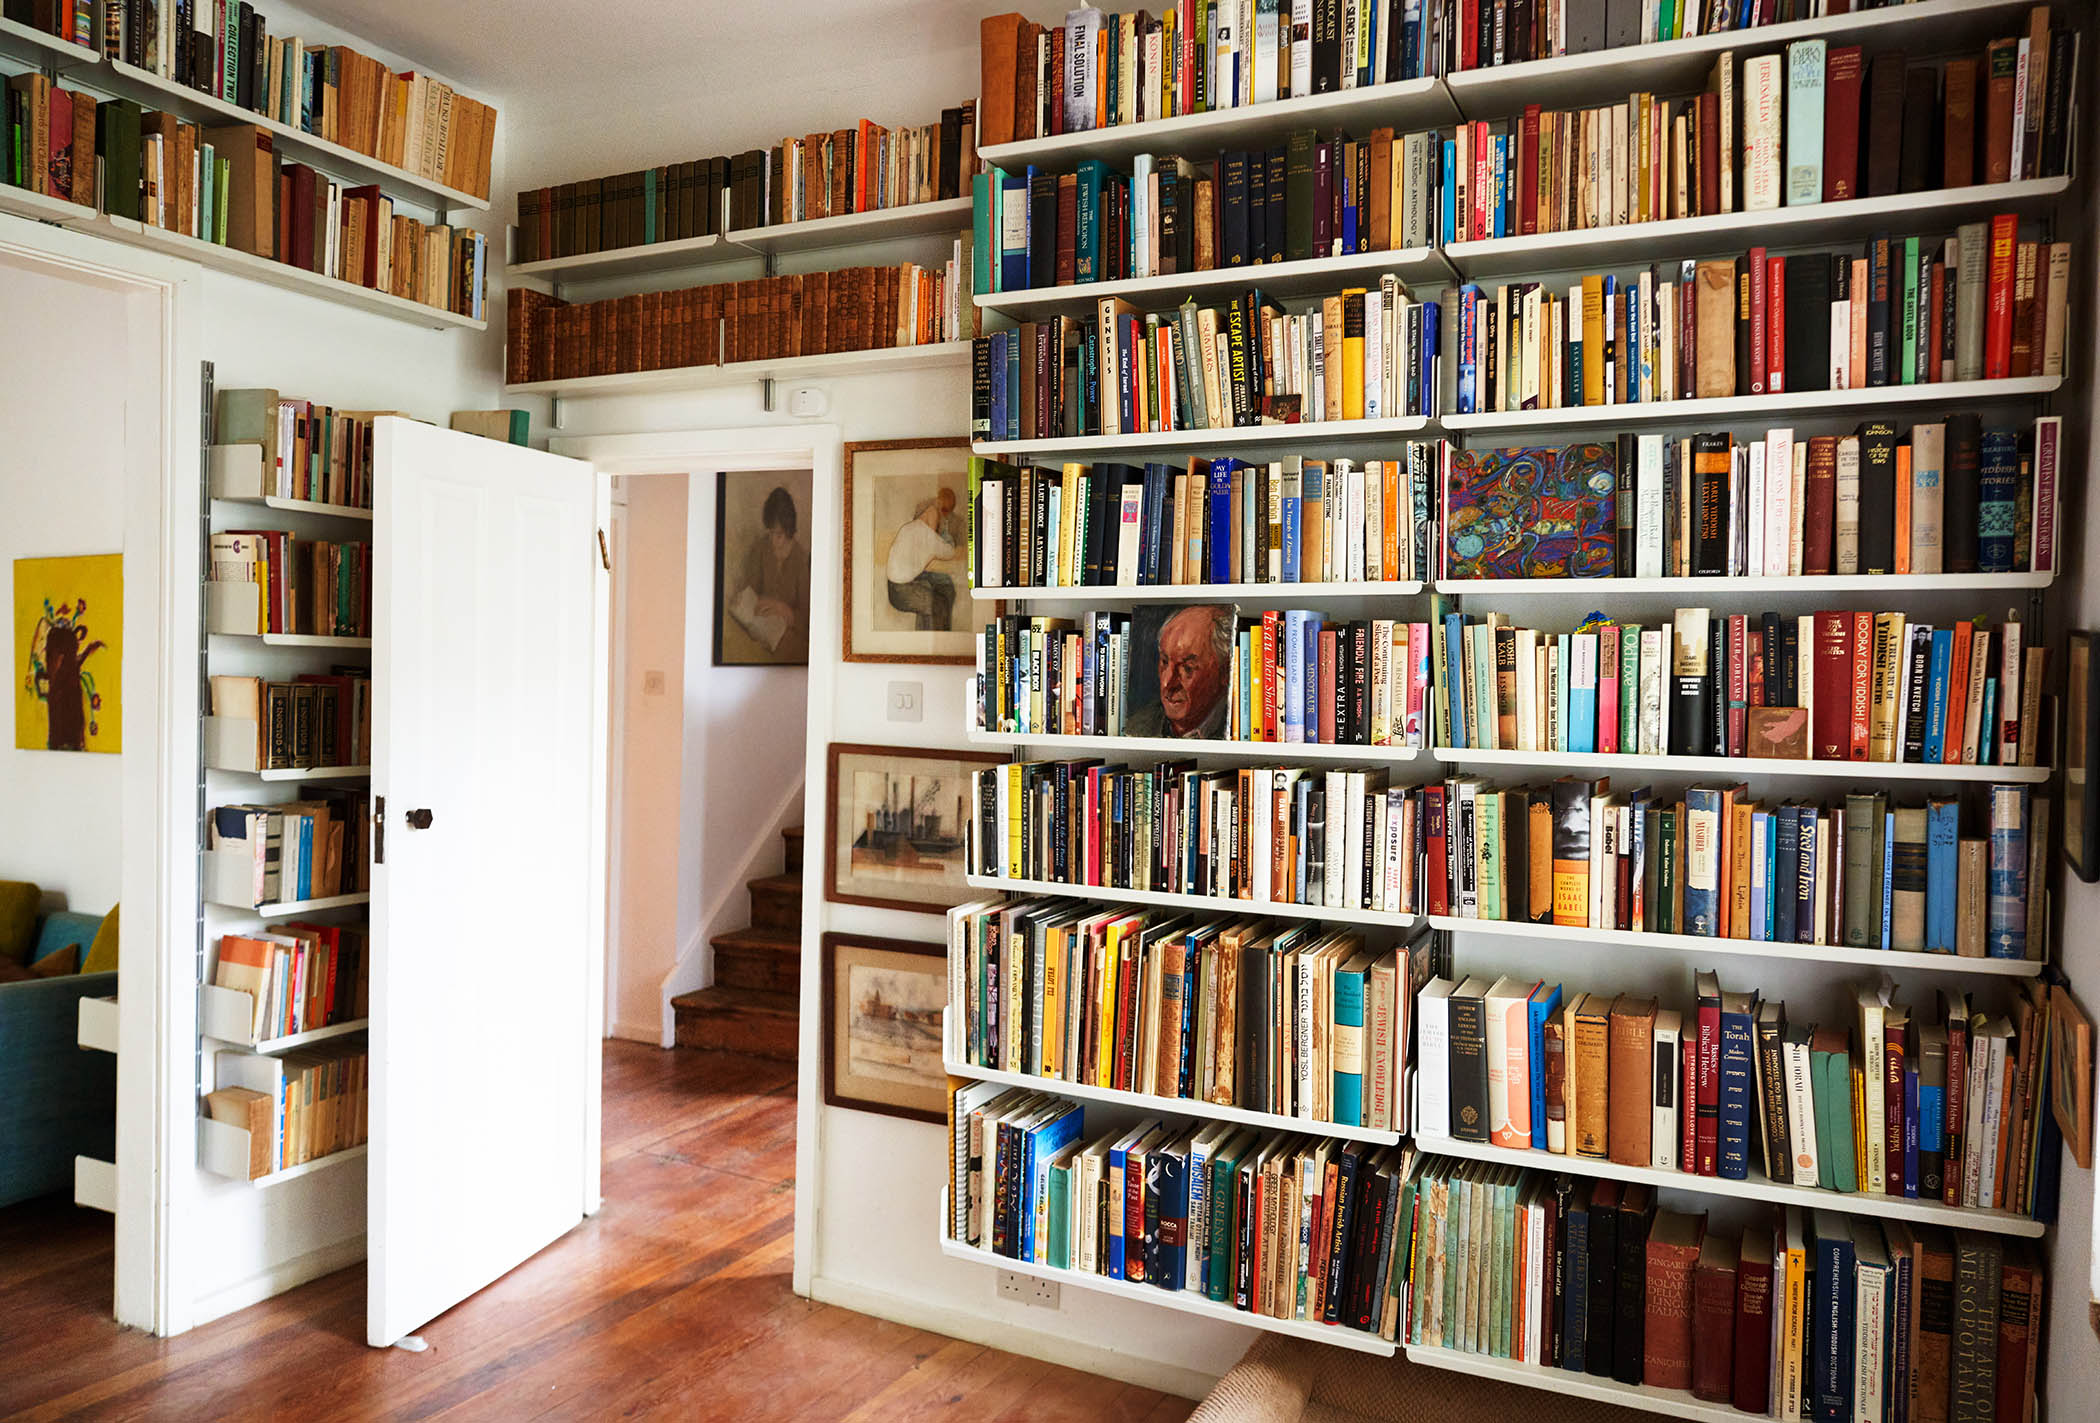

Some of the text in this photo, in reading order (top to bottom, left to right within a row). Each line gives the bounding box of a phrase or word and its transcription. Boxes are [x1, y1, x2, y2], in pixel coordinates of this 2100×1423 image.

[1346, 6, 1356, 36] SILENCE
[225, 23, 238, 100] COLLECTION TWO
[1073, 25, 1086, 98] FINAL SOLUTION
[1149, 36, 1158, 74] KONIN
[1759, 61, 1771, 123] JERUSALEM
[1081, 182, 1089, 211] JEWISH
[1410, 189, 1418, 236] ANTHOLOGY
[1457, 184, 1465, 229] ON JUDAISM
[1994, 239, 2012, 258] KID
[1383, 279, 1393, 311] ALL ABOUT
[1105, 306, 1114, 375] GENESIS
[1203, 323, 1213, 373] SURVIVORS
[1230, 312, 1242, 346] ESCAPE
[1466, 292, 1475, 365] Why Blame Israel?
[1037, 334, 1046, 374] Jerusalem
[1087, 334, 1098, 376] Catastrophe
[1232, 350, 1245, 383] ARTIST
[1089, 380, 1098, 404] Power
[1122, 376, 1130, 394] Israel
[1037, 489, 1045, 503] LATE
[1037, 504, 1045, 528] DIVORCE
[1268, 479, 1280, 520] Ben Gurion
[1709, 481, 1719, 540] EARLY YIDDISH
[1291, 616, 1298, 627] MY
[1374, 624, 1382, 648] Silence
[1735, 619, 1744, 652] MASTER
[1890, 633, 1897, 641] A
[1031, 651, 1041, 691] BLACK BOX
[1263, 614, 1275, 718] Esau Meir Shalev
[1354, 628, 1365, 684] FRIENDLY FIRE
[1374, 650, 1382, 659] of
[1379, 625, 1390, 685] The Continuing
[1497, 642, 1506, 665] KALB
[1506, 638, 1515, 665] YOSHE
[1623, 634, 1638, 686] Old Love
[1855, 615, 1869, 721] HOORAY FOR YIDDISH!
[1874, 620, 1891, 706] YIDDISH POETRY
[1887, 642, 1897, 684] TREASURY
[1306, 663, 1316, 714] MINOTAUR
[1373, 667, 1381, 685] Poet
[1735, 661, 1743, 699] DREAMS
[1911, 654, 1925, 713] BORN TO KVETCH
[1336, 686, 1346, 739] THE EXTRA
[1931, 677, 1942, 737] YIDDISH LITERATURE
[1153, 790, 1161, 814] AHARON
[1447, 800, 1456, 833] Nineteen
[1278, 798, 1287, 862] DAVID GROSSMAN
[1388, 813, 1400, 862] exposure
[1447, 843, 1455, 854] the
[1604, 825, 1614, 855] Babel
[1695, 821, 1706, 852] MASHBER
[1447, 854, 1455, 880] Dozen
[1799, 824, 1816, 900] Steel and Iron
[1558, 903, 1582, 912] BABEL
[1559, 893, 1583, 901] ISAAC
[1031, 953, 1045, 1048] PISANELLO
[1300, 1017, 1310, 1081] YOSL BERGNER
[1724, 1030, 1750, 1042] Torah
[1731, 1025, 1743, 1034] THE
[1374, 1006, 1387, 1115] JEWISH KNOWLEDGE
[1700, 1024, 1712, 1088] Biblical Hebrew
[1711, 1043, 1720, 1069] Basics
[1793, 1049, 1804, 1092] THE TORAH
[1690, 1081, 1696, 1090] AS
[1190, 1151, 1206, 1201] JERUSALEM
[1215, 1189, 1225, 1243] GREENS
[1270, 1173, 1278, 1236] GREEK MYTHOLOGY
[1333, 1174, 1349, 1254] Russian Jewish Artists
[1829, 1248, 1840, 1393] COMPREHENSIVE ENGLISH-YIDDISH DICTIONARY
[1978, 1307, 1993, 1347] THE
[1860, 1322, 1869, 1415] YIDDISH-ENGLISH DICTIONARY
[1976, 1353, 1992, 1394] ART
